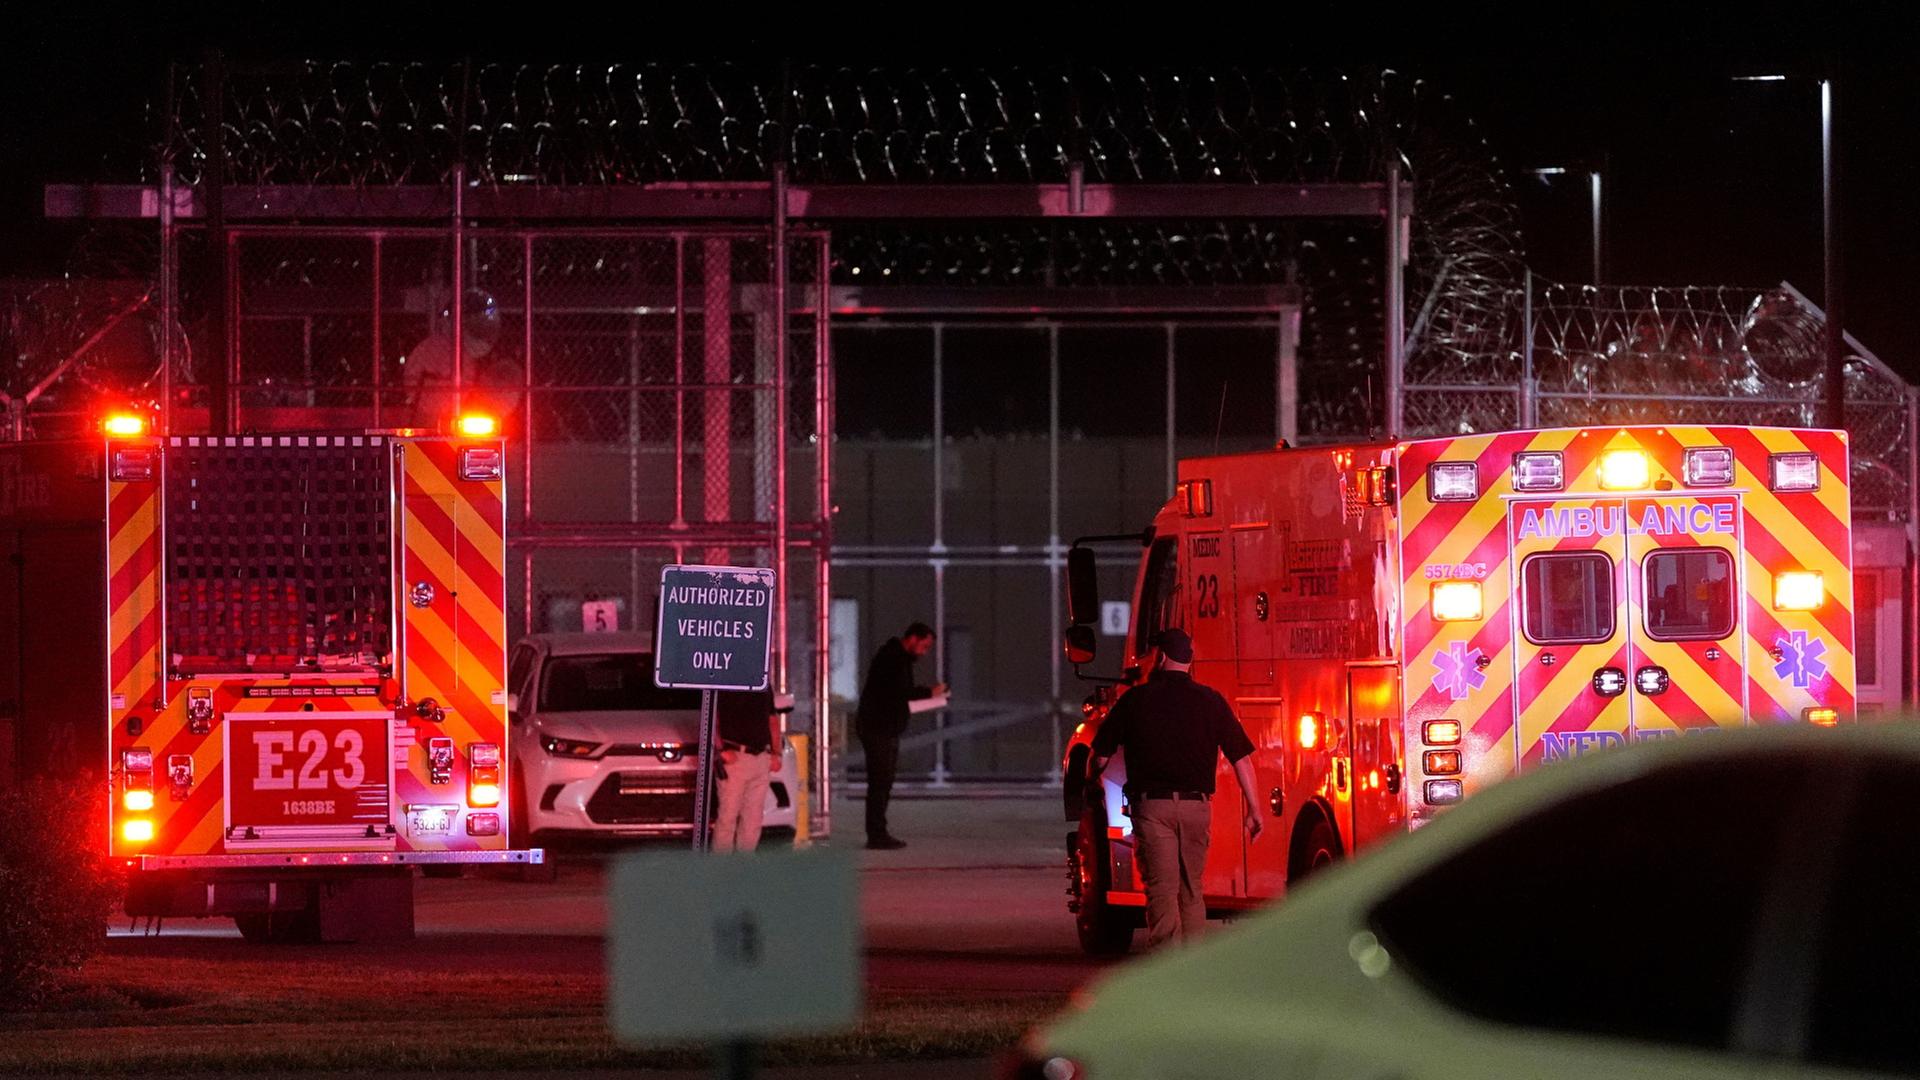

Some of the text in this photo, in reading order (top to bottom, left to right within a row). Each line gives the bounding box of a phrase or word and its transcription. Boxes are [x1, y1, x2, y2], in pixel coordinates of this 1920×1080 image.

[1518, 504, 1734, 539] AMBULANCE
[1193, 538, 1220, 557] MEDIC
[1197, 574, 1219, 618] 23
[1299, 575, 1338, 596] FIRE
[668, 586, 766, 607] AUTHORIZED
[595, 609, 606, 632] 5
[1111, 607, 1121, 629] 6
[678, 619, 754, 639] VEHICLES
[692, 651, 733, 670] ONLY
[253, 729, 365, 790] E23
[283, 800, 335, 815] 1638BE
